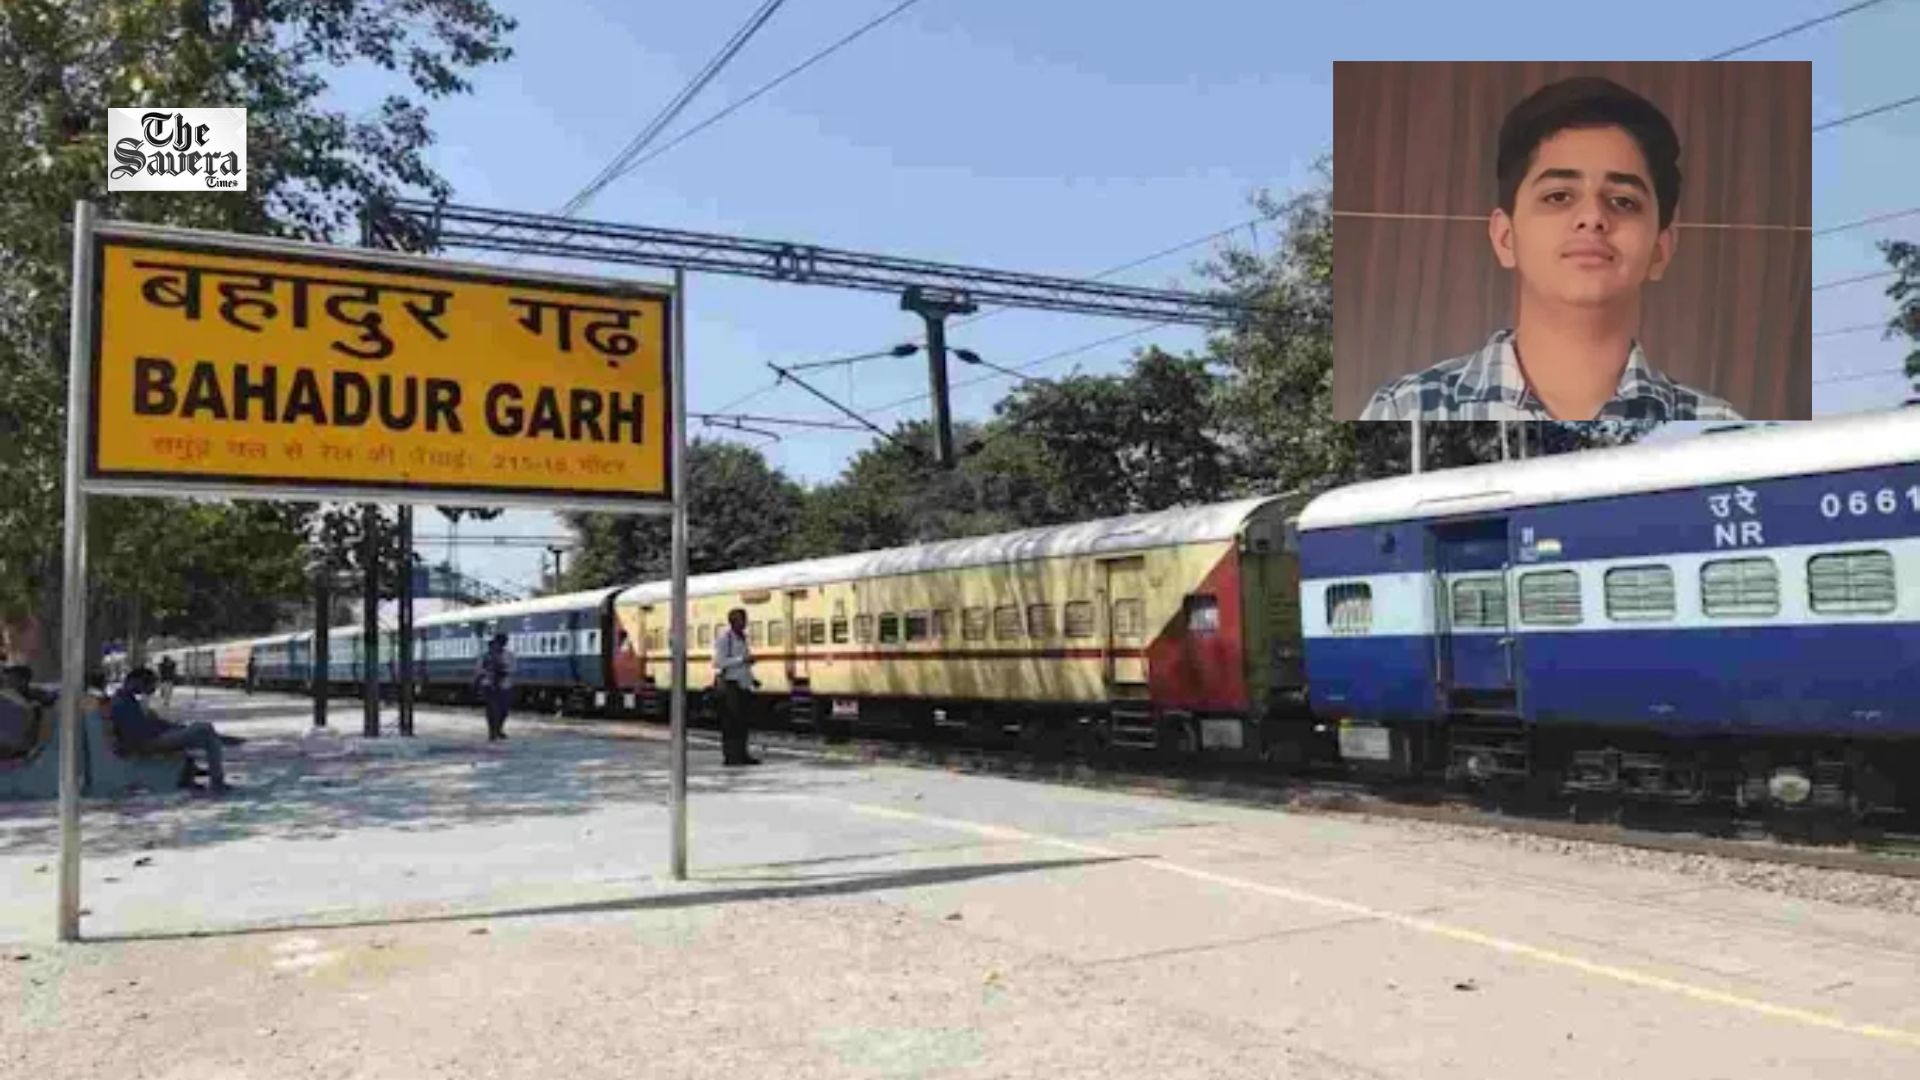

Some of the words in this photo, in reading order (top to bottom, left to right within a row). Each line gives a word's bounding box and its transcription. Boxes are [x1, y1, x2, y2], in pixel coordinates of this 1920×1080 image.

[133, 260, 455, 360] बहादुर
[509, 297, 642, 368] गढ़
[133, 356, 463, 434] BAHADUR
[484, 382, 645, 445] GARH
[1713, 520, 1765, 548] NR
